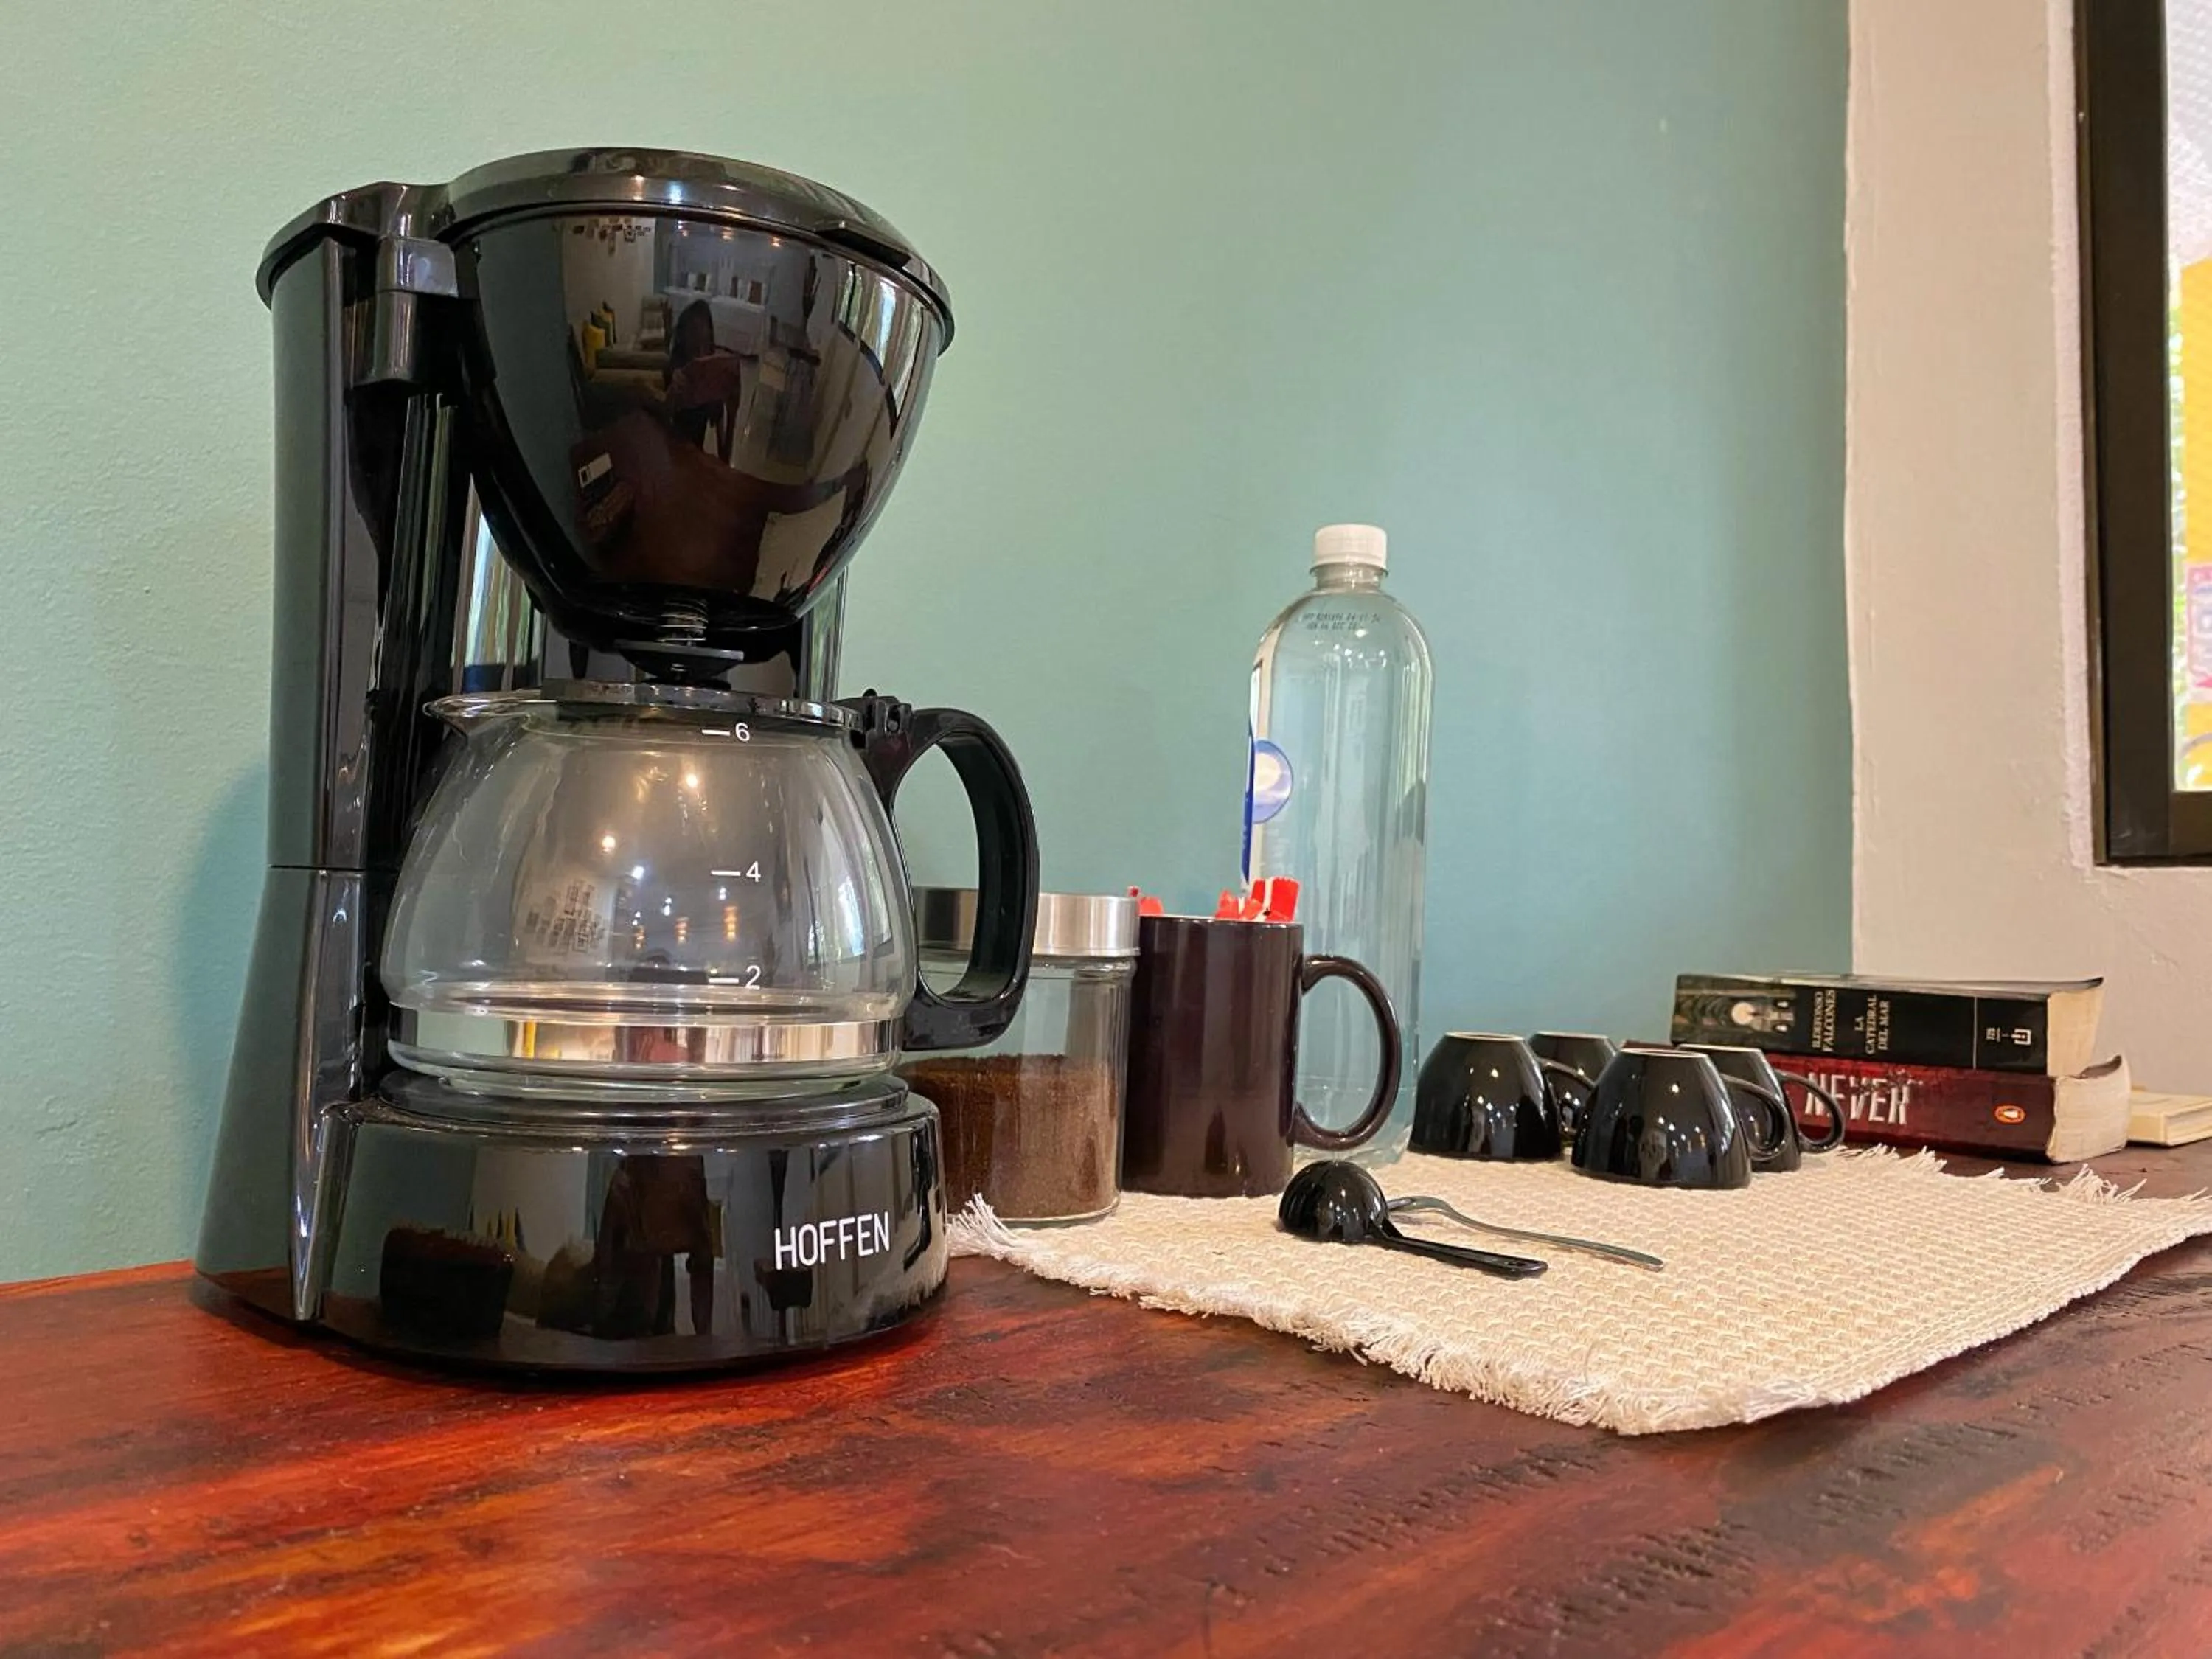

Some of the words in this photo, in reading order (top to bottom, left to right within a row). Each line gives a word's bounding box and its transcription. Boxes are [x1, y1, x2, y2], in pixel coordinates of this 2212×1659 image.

[734, 722, 751, 742] 6
[745, 860, 762, 883] 4
[745, 965, 761, 990] 2
[1812, 990, 1824, 1048] ILDEFONSO
[1821, 989, 1835, 1053] FALCONES
[1854, 1015, 1865, 1032] LA
[1865, 994, 1877, 1055] CATEDRAL
[1879, 1000, 1890, 1026] MAR
[1877, 1028, 1889, 1051] DEL
[774, 1211, 891, 1271] HOFFEN
